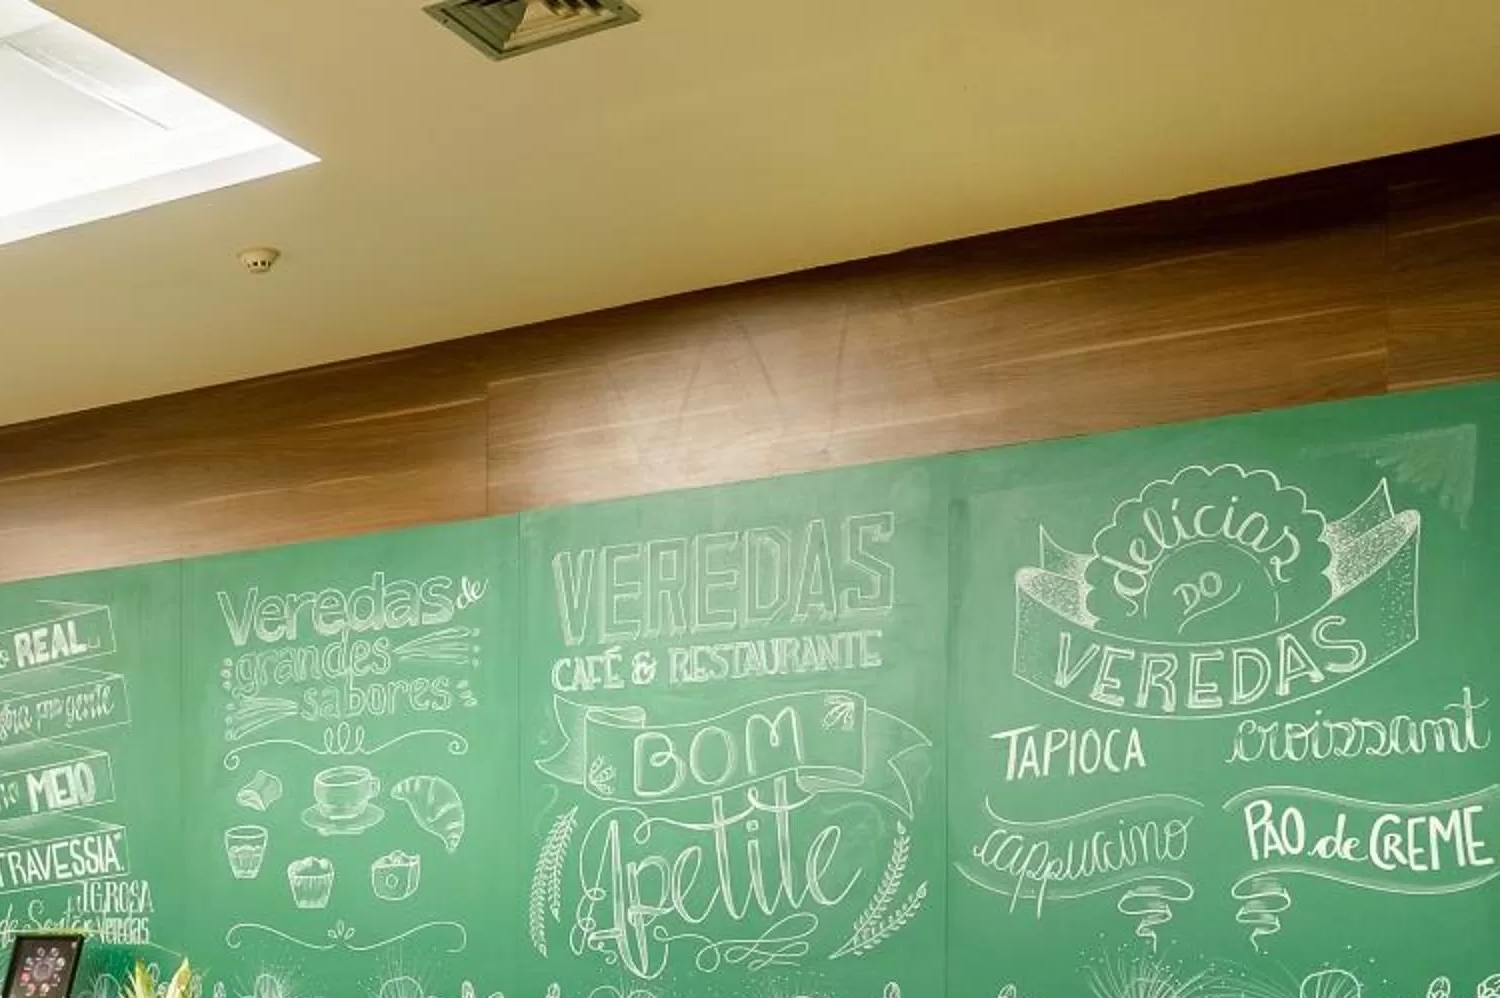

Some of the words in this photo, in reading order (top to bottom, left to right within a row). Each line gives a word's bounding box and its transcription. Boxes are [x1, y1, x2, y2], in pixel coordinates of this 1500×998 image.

[217, 572, 455, 646] Veredas
[552, 511, 895, 647] VEREDAS
[13, 619, 88, 668] REAL
[232, 634, 391, 698] grandes
[551, 646, 624, 692] CAFÉ
[668, 630, 883, 684] RESTAURANTE
[1053, 615, 1367, 712] VEREDAS
[300, 676, 451, 721] sabores
[991, 724, 1147, 781] TAPIOCA
[1225, 686, 1491, 764] croissant
[633, 706, 802, 797] BOM
[26, 762, 97, 812] MEIO
[1307, 813, 1369, 862] de
[1369, 805, 1495, 872] CREME
[570, 776, 862, 979] Apetite
